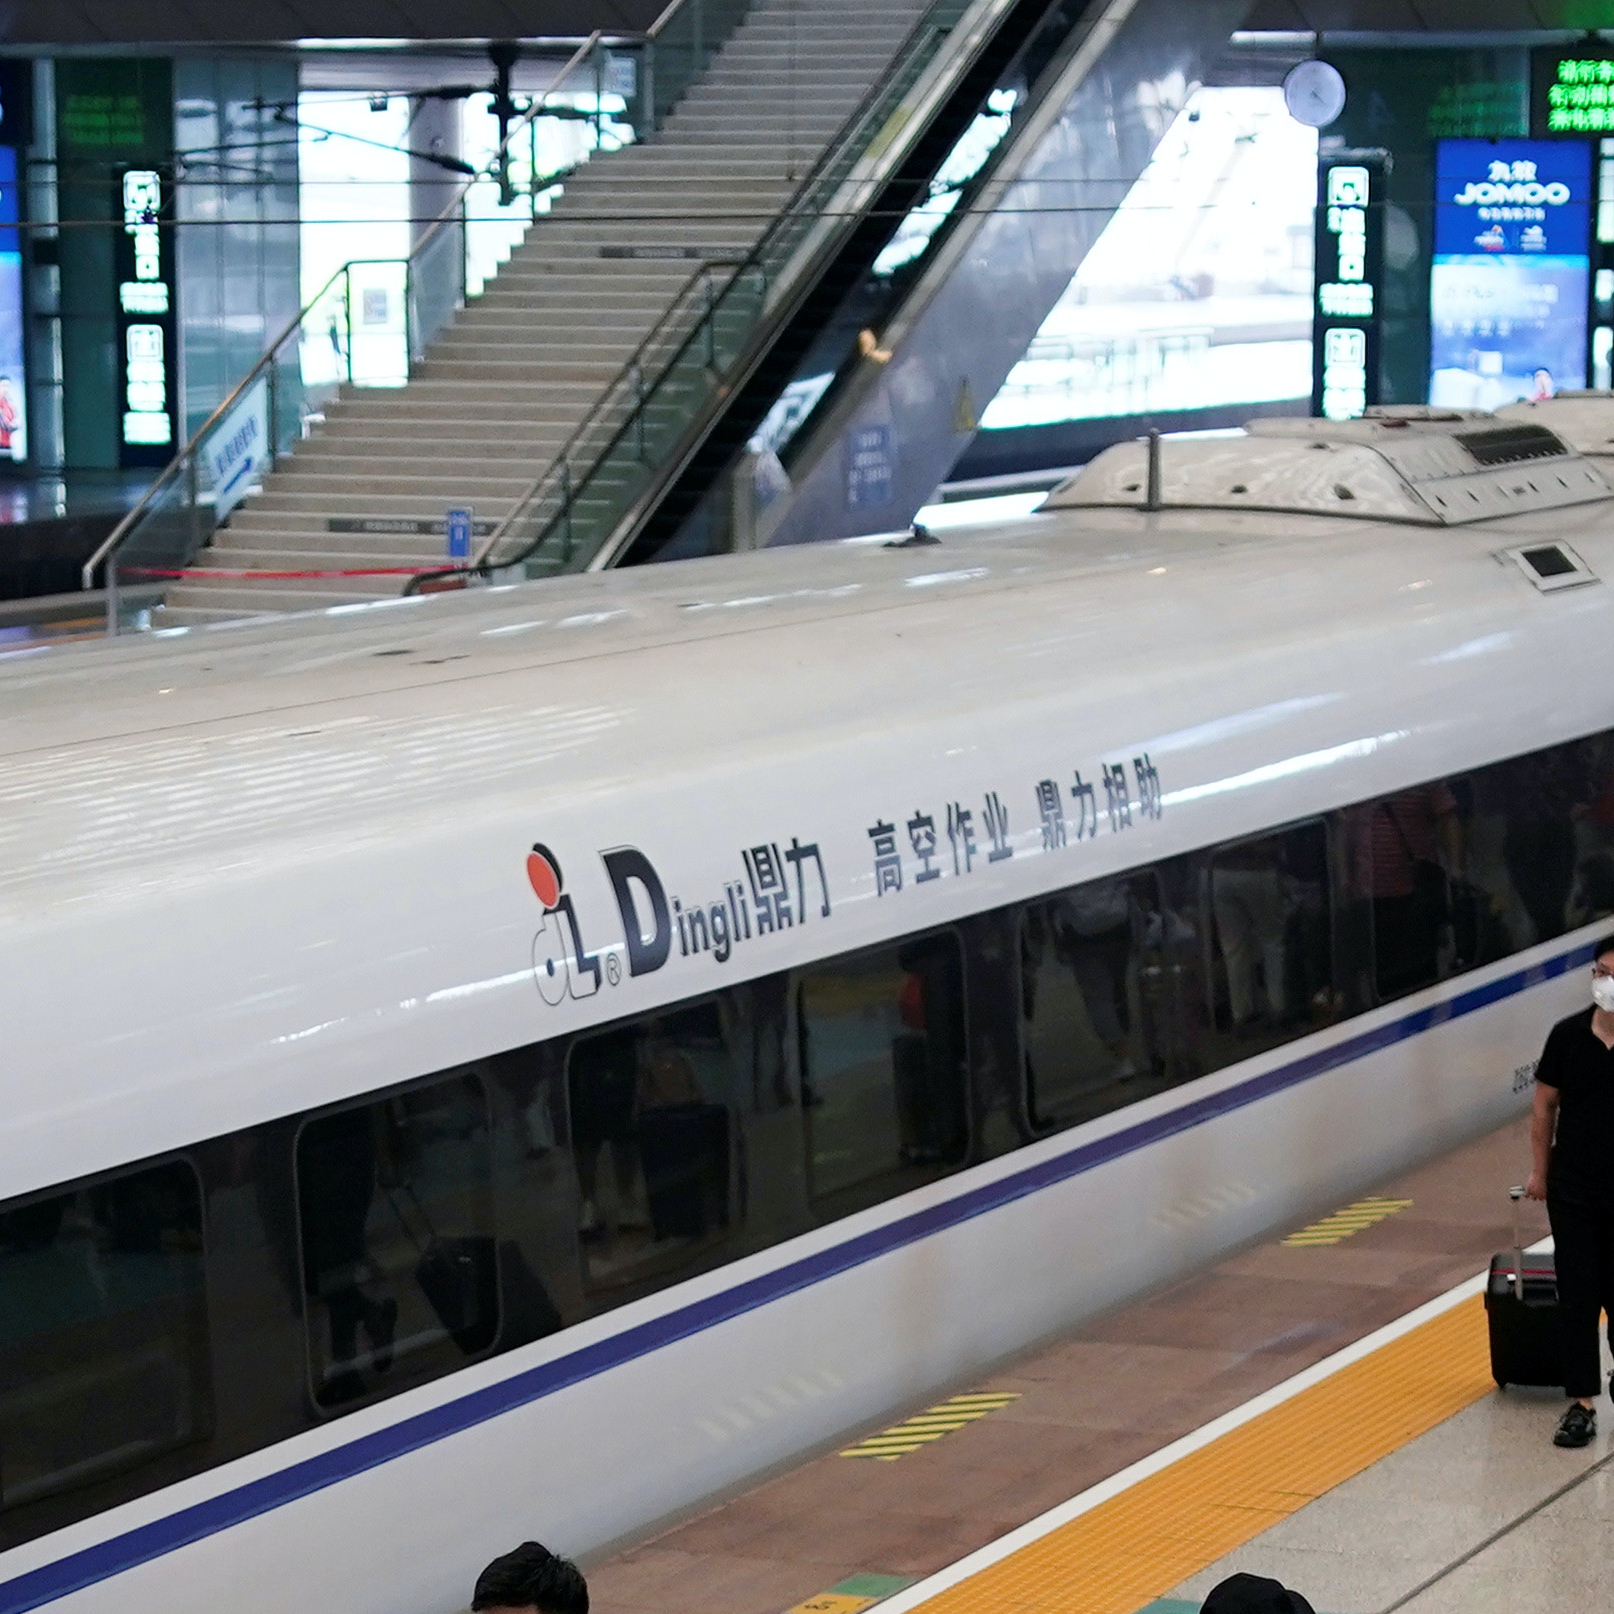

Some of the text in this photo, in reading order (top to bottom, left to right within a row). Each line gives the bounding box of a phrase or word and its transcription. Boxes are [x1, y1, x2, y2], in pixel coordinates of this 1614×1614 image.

[1453, 182, 1571, 206] JOMOO
[868, 790, 1013, 897] 高空作业
[1035, 753, 1162, 851] 鼎力相助
